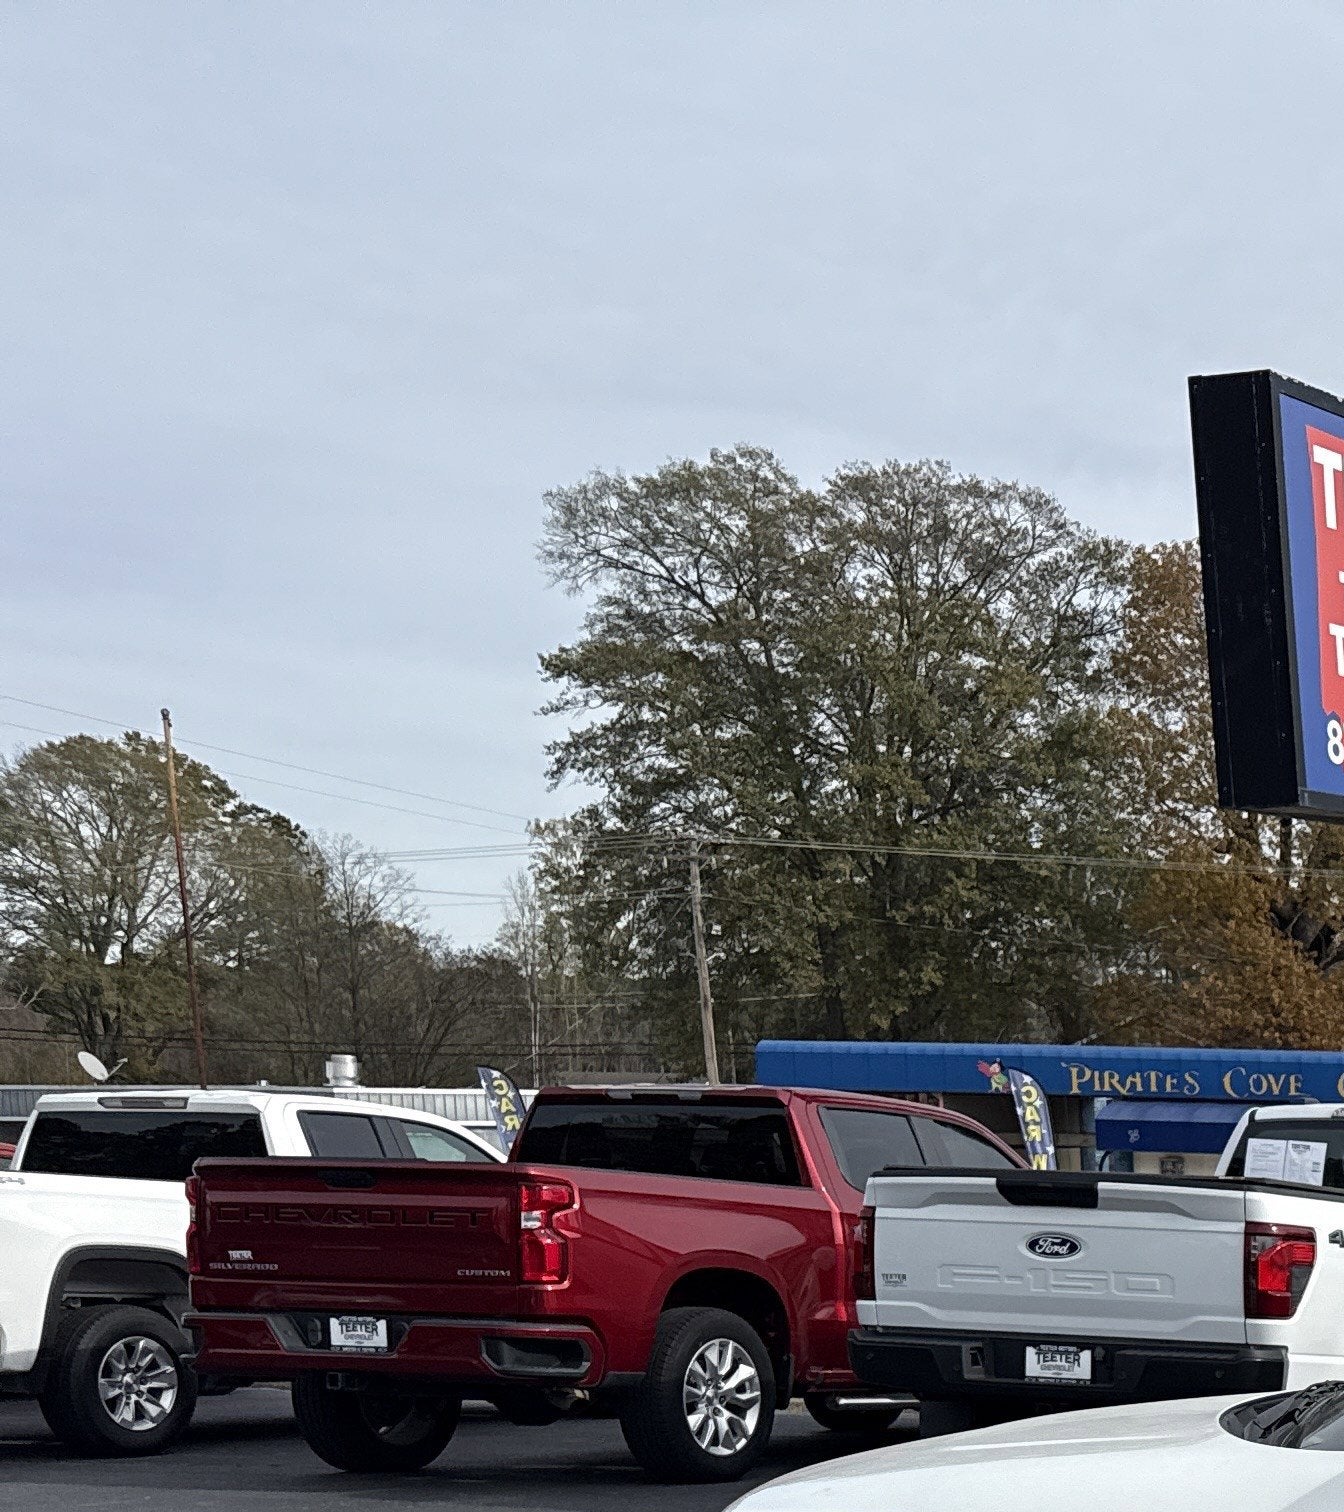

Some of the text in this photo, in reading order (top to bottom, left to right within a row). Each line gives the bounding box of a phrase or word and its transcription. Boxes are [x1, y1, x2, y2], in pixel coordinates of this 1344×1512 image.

[1060, 1062, 1200, 1096] PIRATES
[1222, 1066, 1305, 1099] COVE
[214, 1204, 490, 1230] CHEVROLET
[1035, 1237, 1072, 1256] Ford
[208, 1262, 279, 1271] SILVERADO
[457, 1269, 511, 1277] CUSTOM
[936, 1263, 1175, 1298] F-150
[339, 1319, 379, 1337] TEETER
[1035, 1350, 1081, 1369] TEETER
